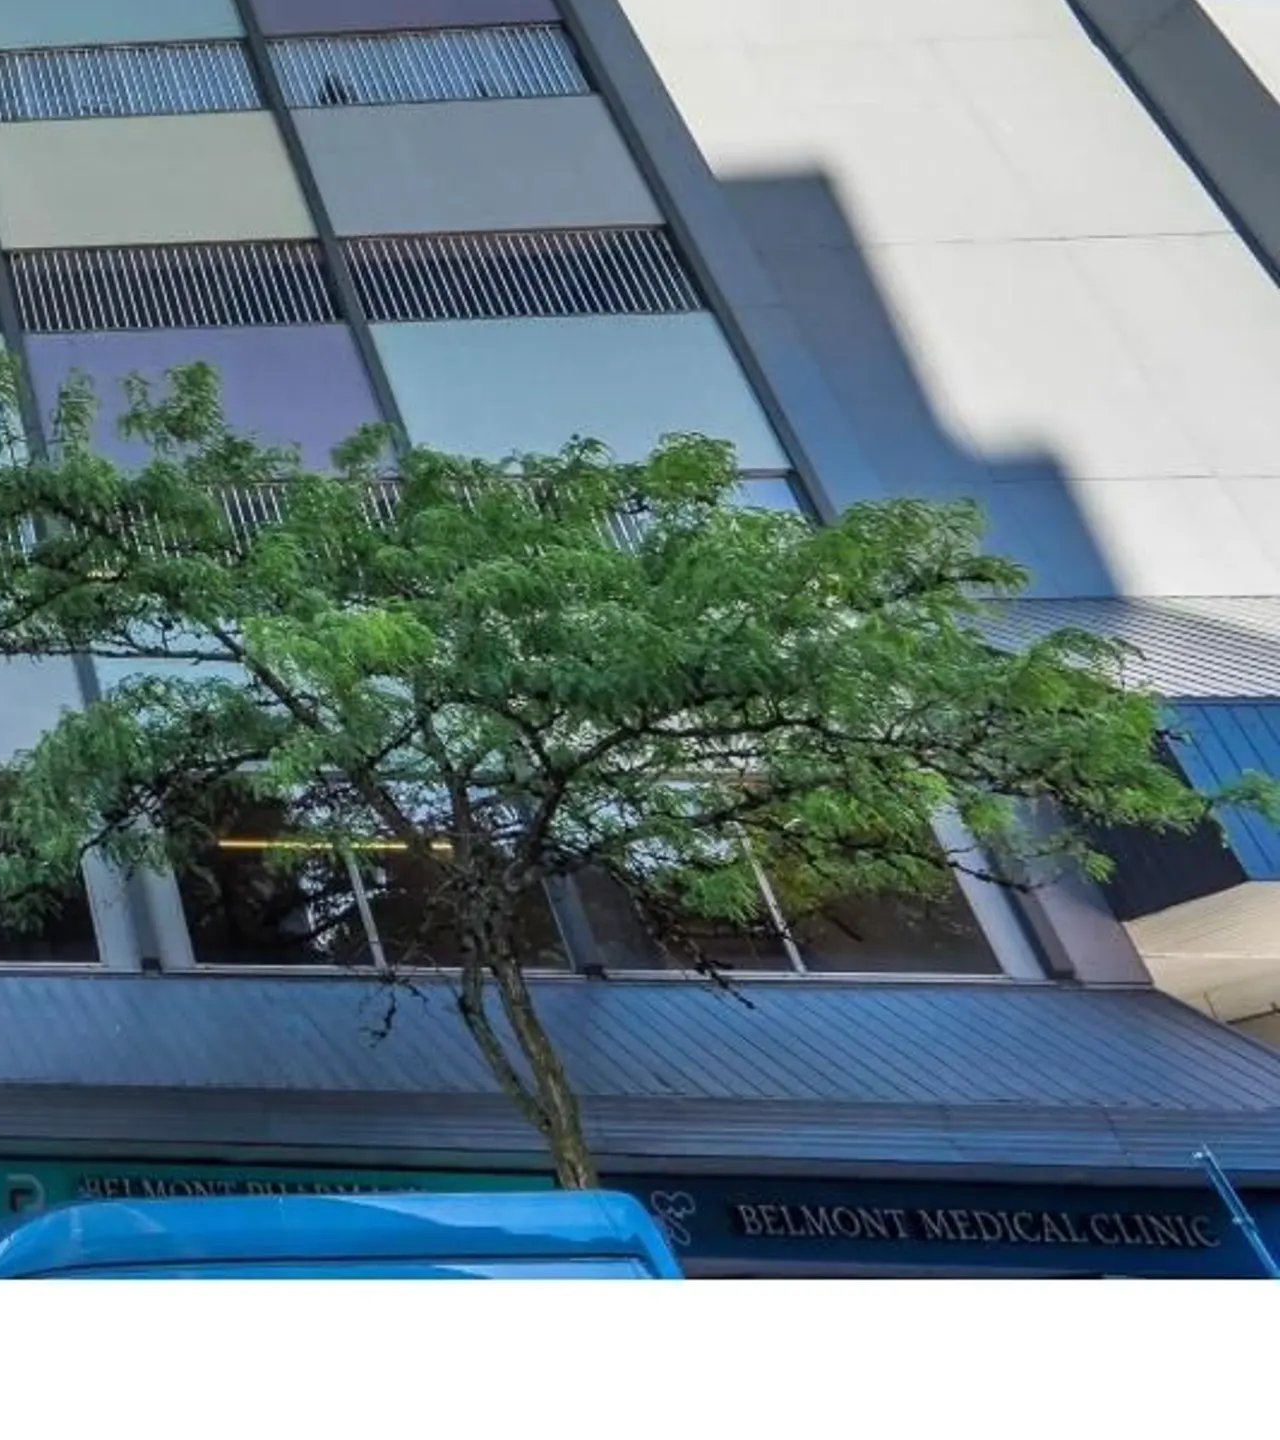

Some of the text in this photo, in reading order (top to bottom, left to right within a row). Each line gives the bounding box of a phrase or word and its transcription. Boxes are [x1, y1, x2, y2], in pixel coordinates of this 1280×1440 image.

[737, 1203, 1220, 1248] BELMONT MEDICAL CLINIC
